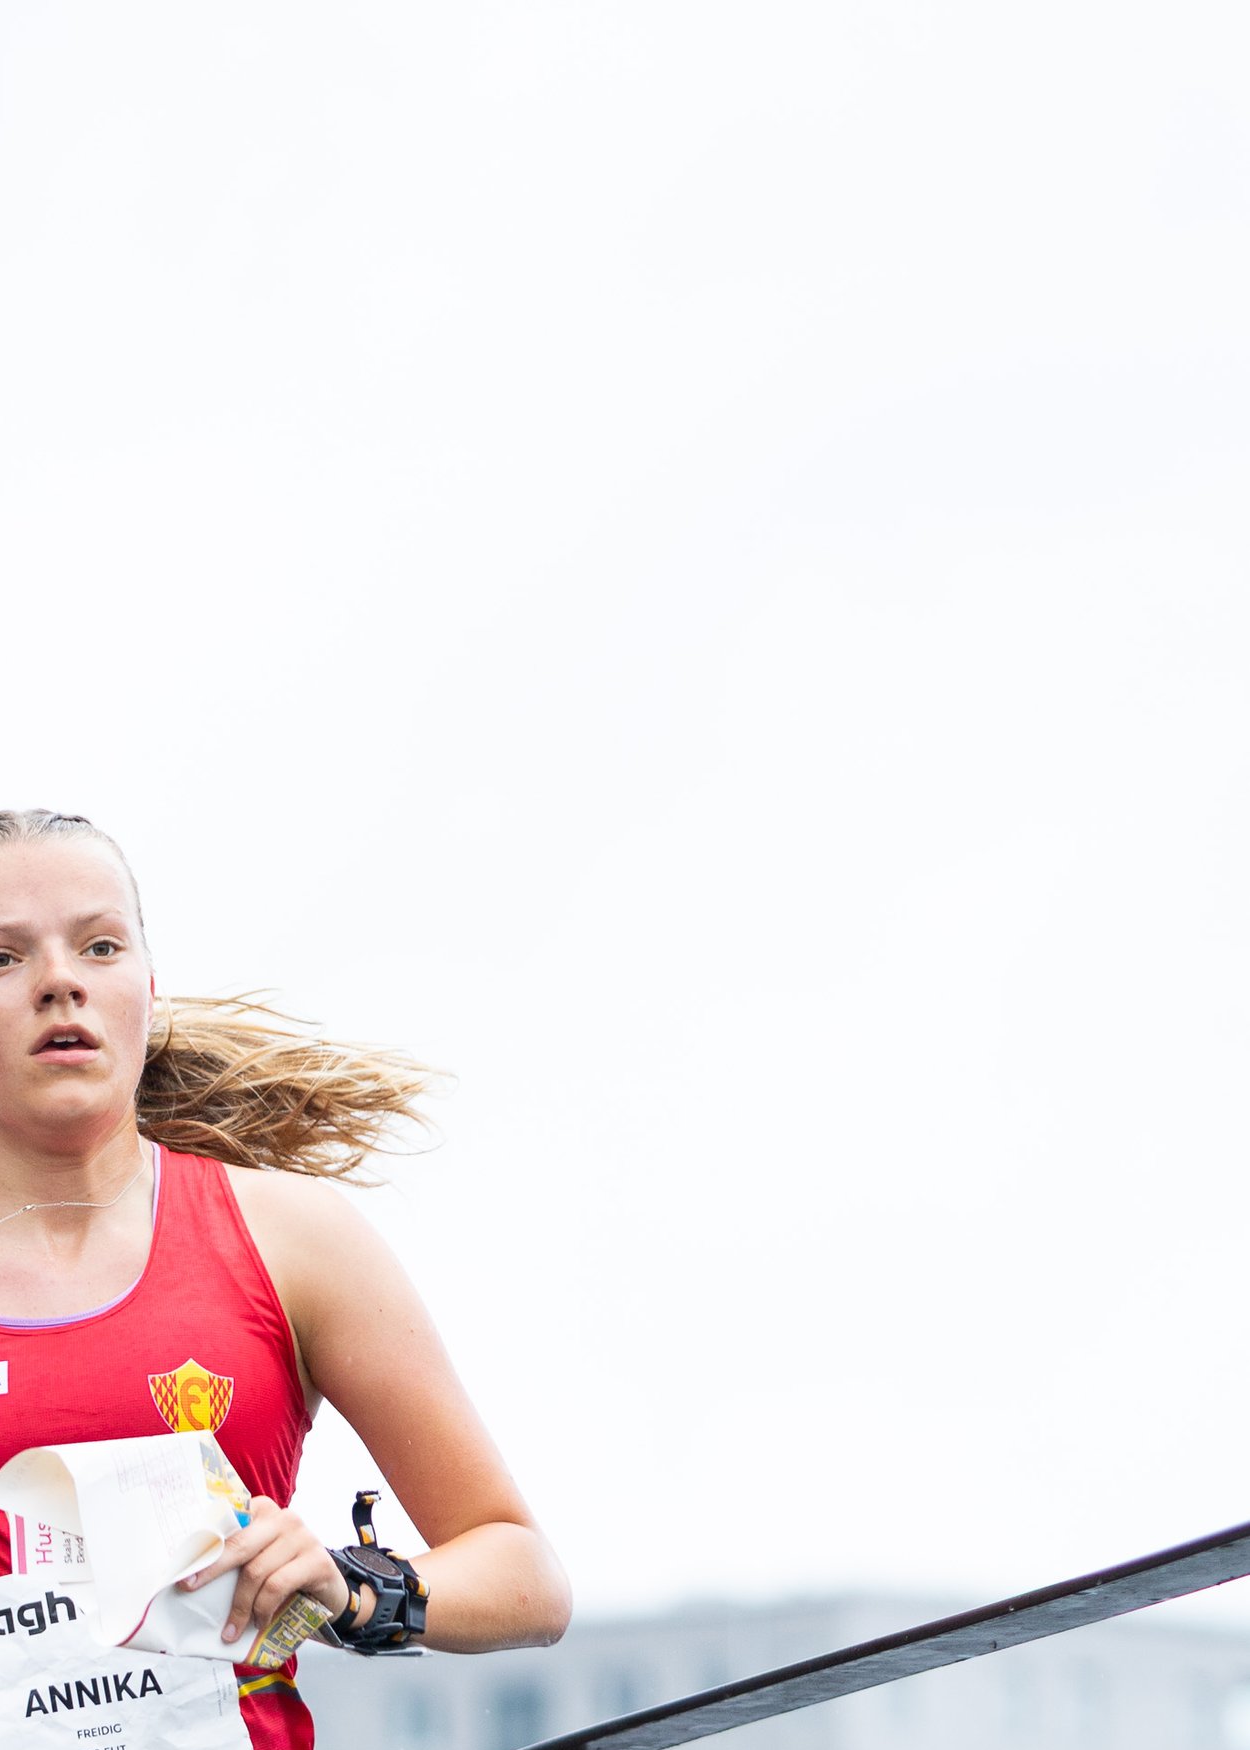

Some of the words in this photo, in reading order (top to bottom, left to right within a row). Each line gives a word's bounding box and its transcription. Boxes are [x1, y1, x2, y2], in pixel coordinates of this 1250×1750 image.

[36, 1522, 53, 1564] Hus
[25, 1668, 163, 1718] ANNIKA
[77, 1723, 123, 1739] FREIDIG
